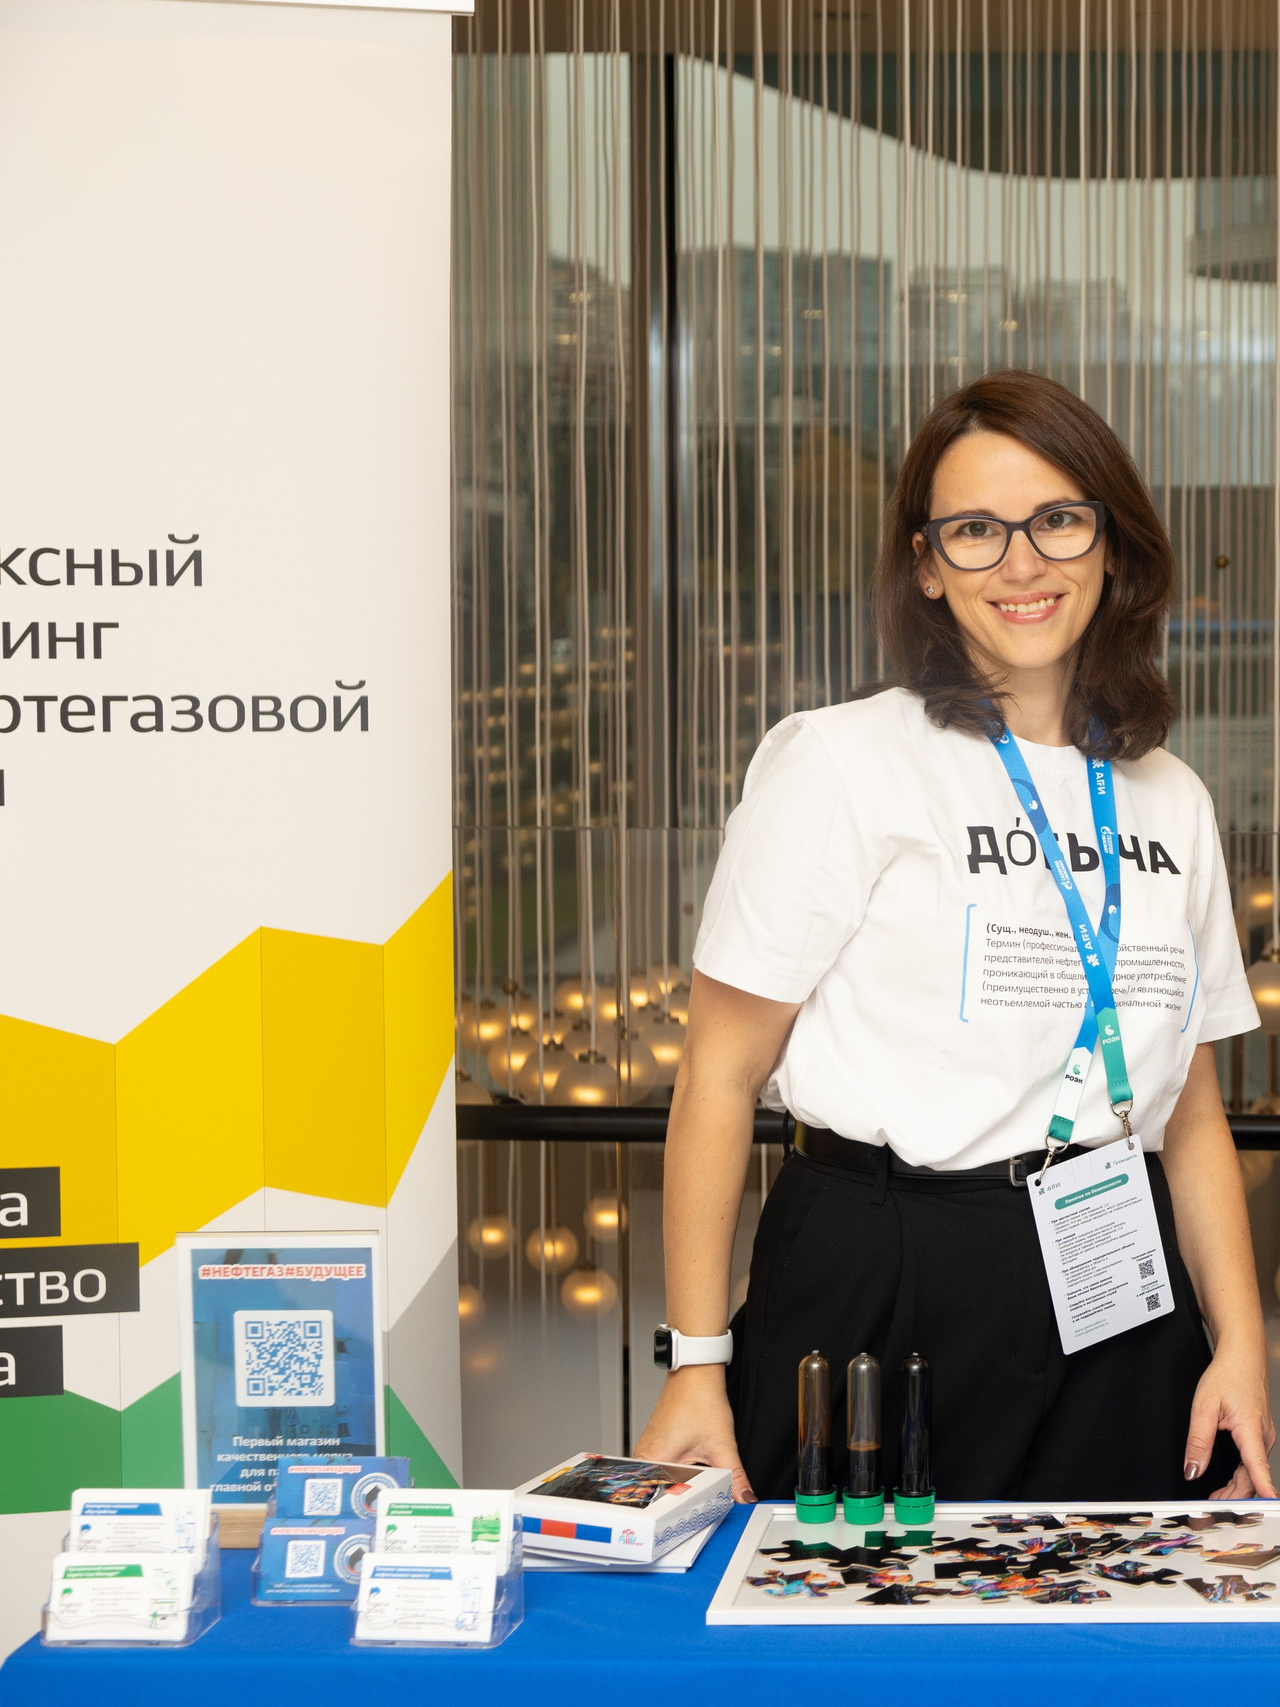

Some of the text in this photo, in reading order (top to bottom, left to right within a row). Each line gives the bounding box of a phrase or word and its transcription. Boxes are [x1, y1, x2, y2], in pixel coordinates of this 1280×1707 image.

[2, 621, 120, 659] инг
[1018, 926, 1054, 938] неодуш.,
[1055, 931, 1071, 939] жен.
[986, 938, 1020, 949] Термин
[1169, 946, 1185, 955] речи
[984, 954, 1054, 964] представителей
[983, 968, 1048, 979] проникающий
[982, 981, 1069, 995] (преимущественно
[980, 998, 1050, 1008] неотъемлемой
[1052, 1001, 1082, 1009] частью
[1102, 1035, 1120, 1045] РОЭК
[1065, 1074, 1083, 1084] РОЭК
[200, 1265, 365, 1280] #НЕФТЕГАЗ#БУДУЩЕЕ
[232, 1435, 341, 1448] Первый магазин
[240, 1469, 265, 1478] для
[209, 1481, 262, 1492] главной
